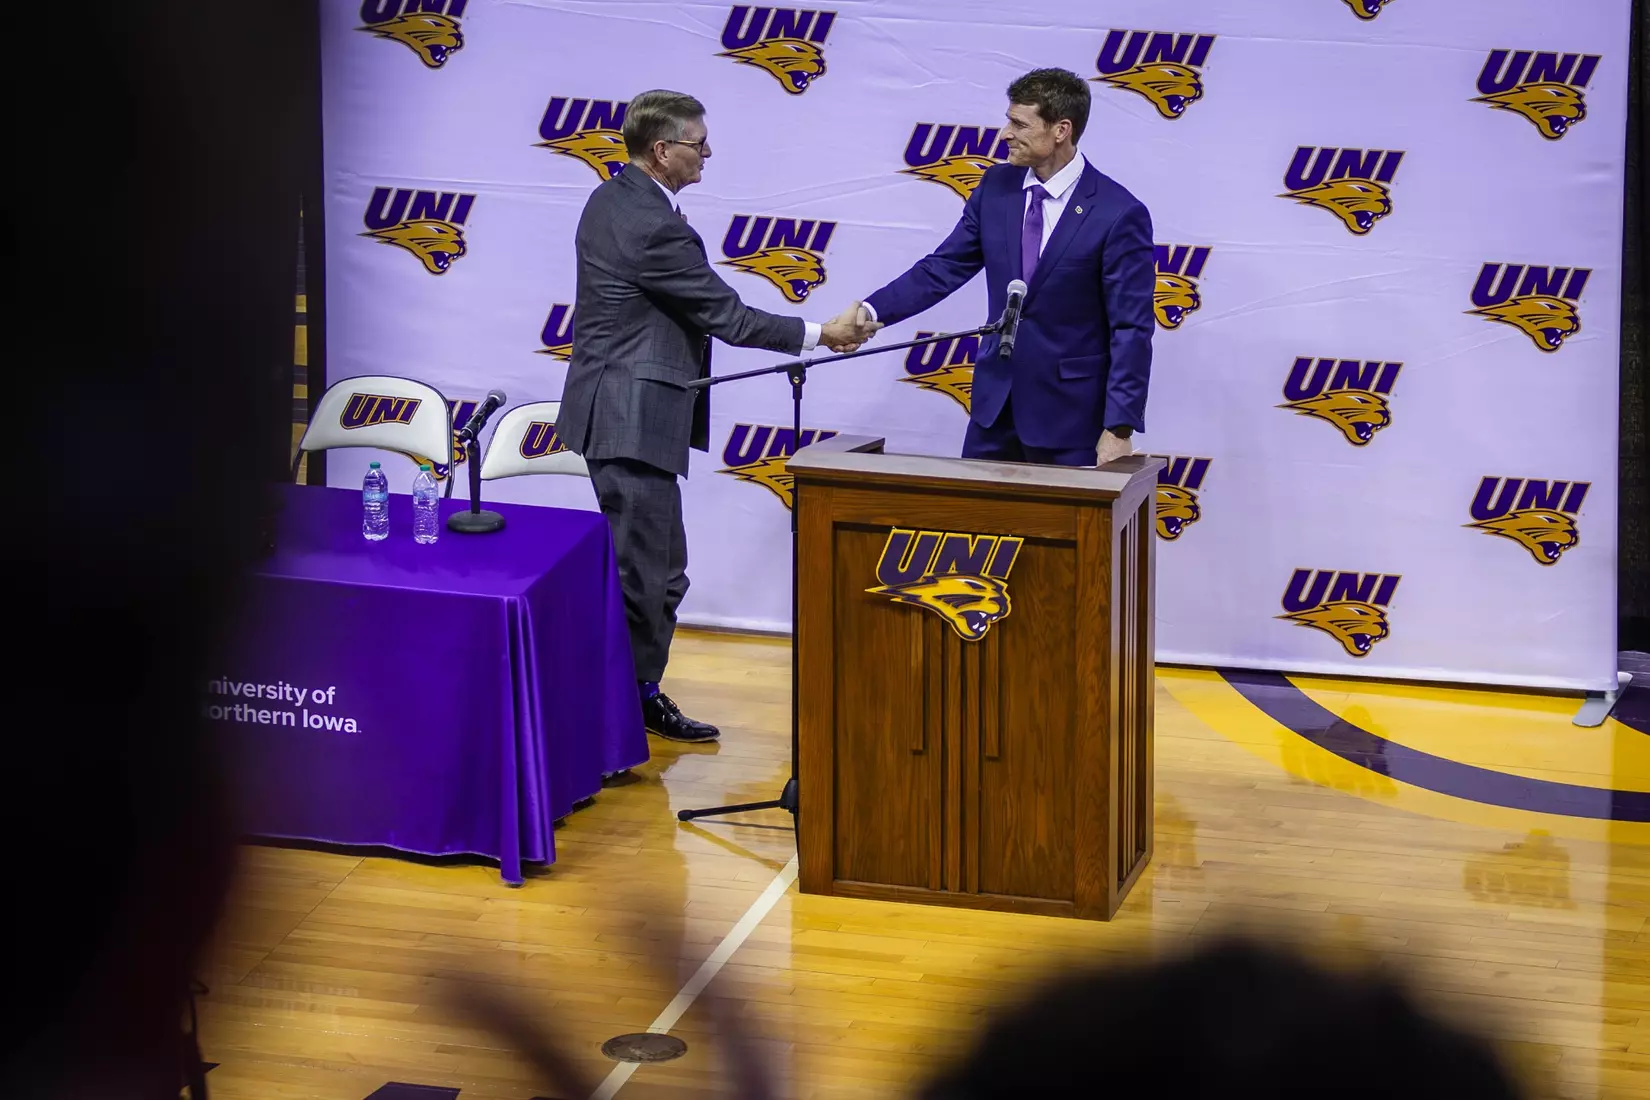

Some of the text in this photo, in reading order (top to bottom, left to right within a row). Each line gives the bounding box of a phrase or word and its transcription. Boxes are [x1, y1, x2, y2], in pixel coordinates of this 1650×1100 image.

[721, 5, 837, 49] UNI
[1096, 28, 1216, 72] UNI
[1476, 49, 1602, 94] UNI
[538, 96, 628, 141] UN
[1283, 146, 1405, 190] UNI
[364, 187, 476, 229] UNI
[721, 214, 837, 257] UNI
[1153, 243, 1213, 280] NI
[1470, 262, 1593, 307] UNI
[1283, 357, 1404, 400] UNI
[340, 393, 422, 430] UNI
[722, 423, 838, 467] UN
[1470, 476, 1592, 520] UNI
[876, 529, 1024, 586] UNI
[1281, 568, 1402, 612] UNI
[208, 676, 336, 706] niversity of
[203, 703, 357, 733] orthern Iowa
